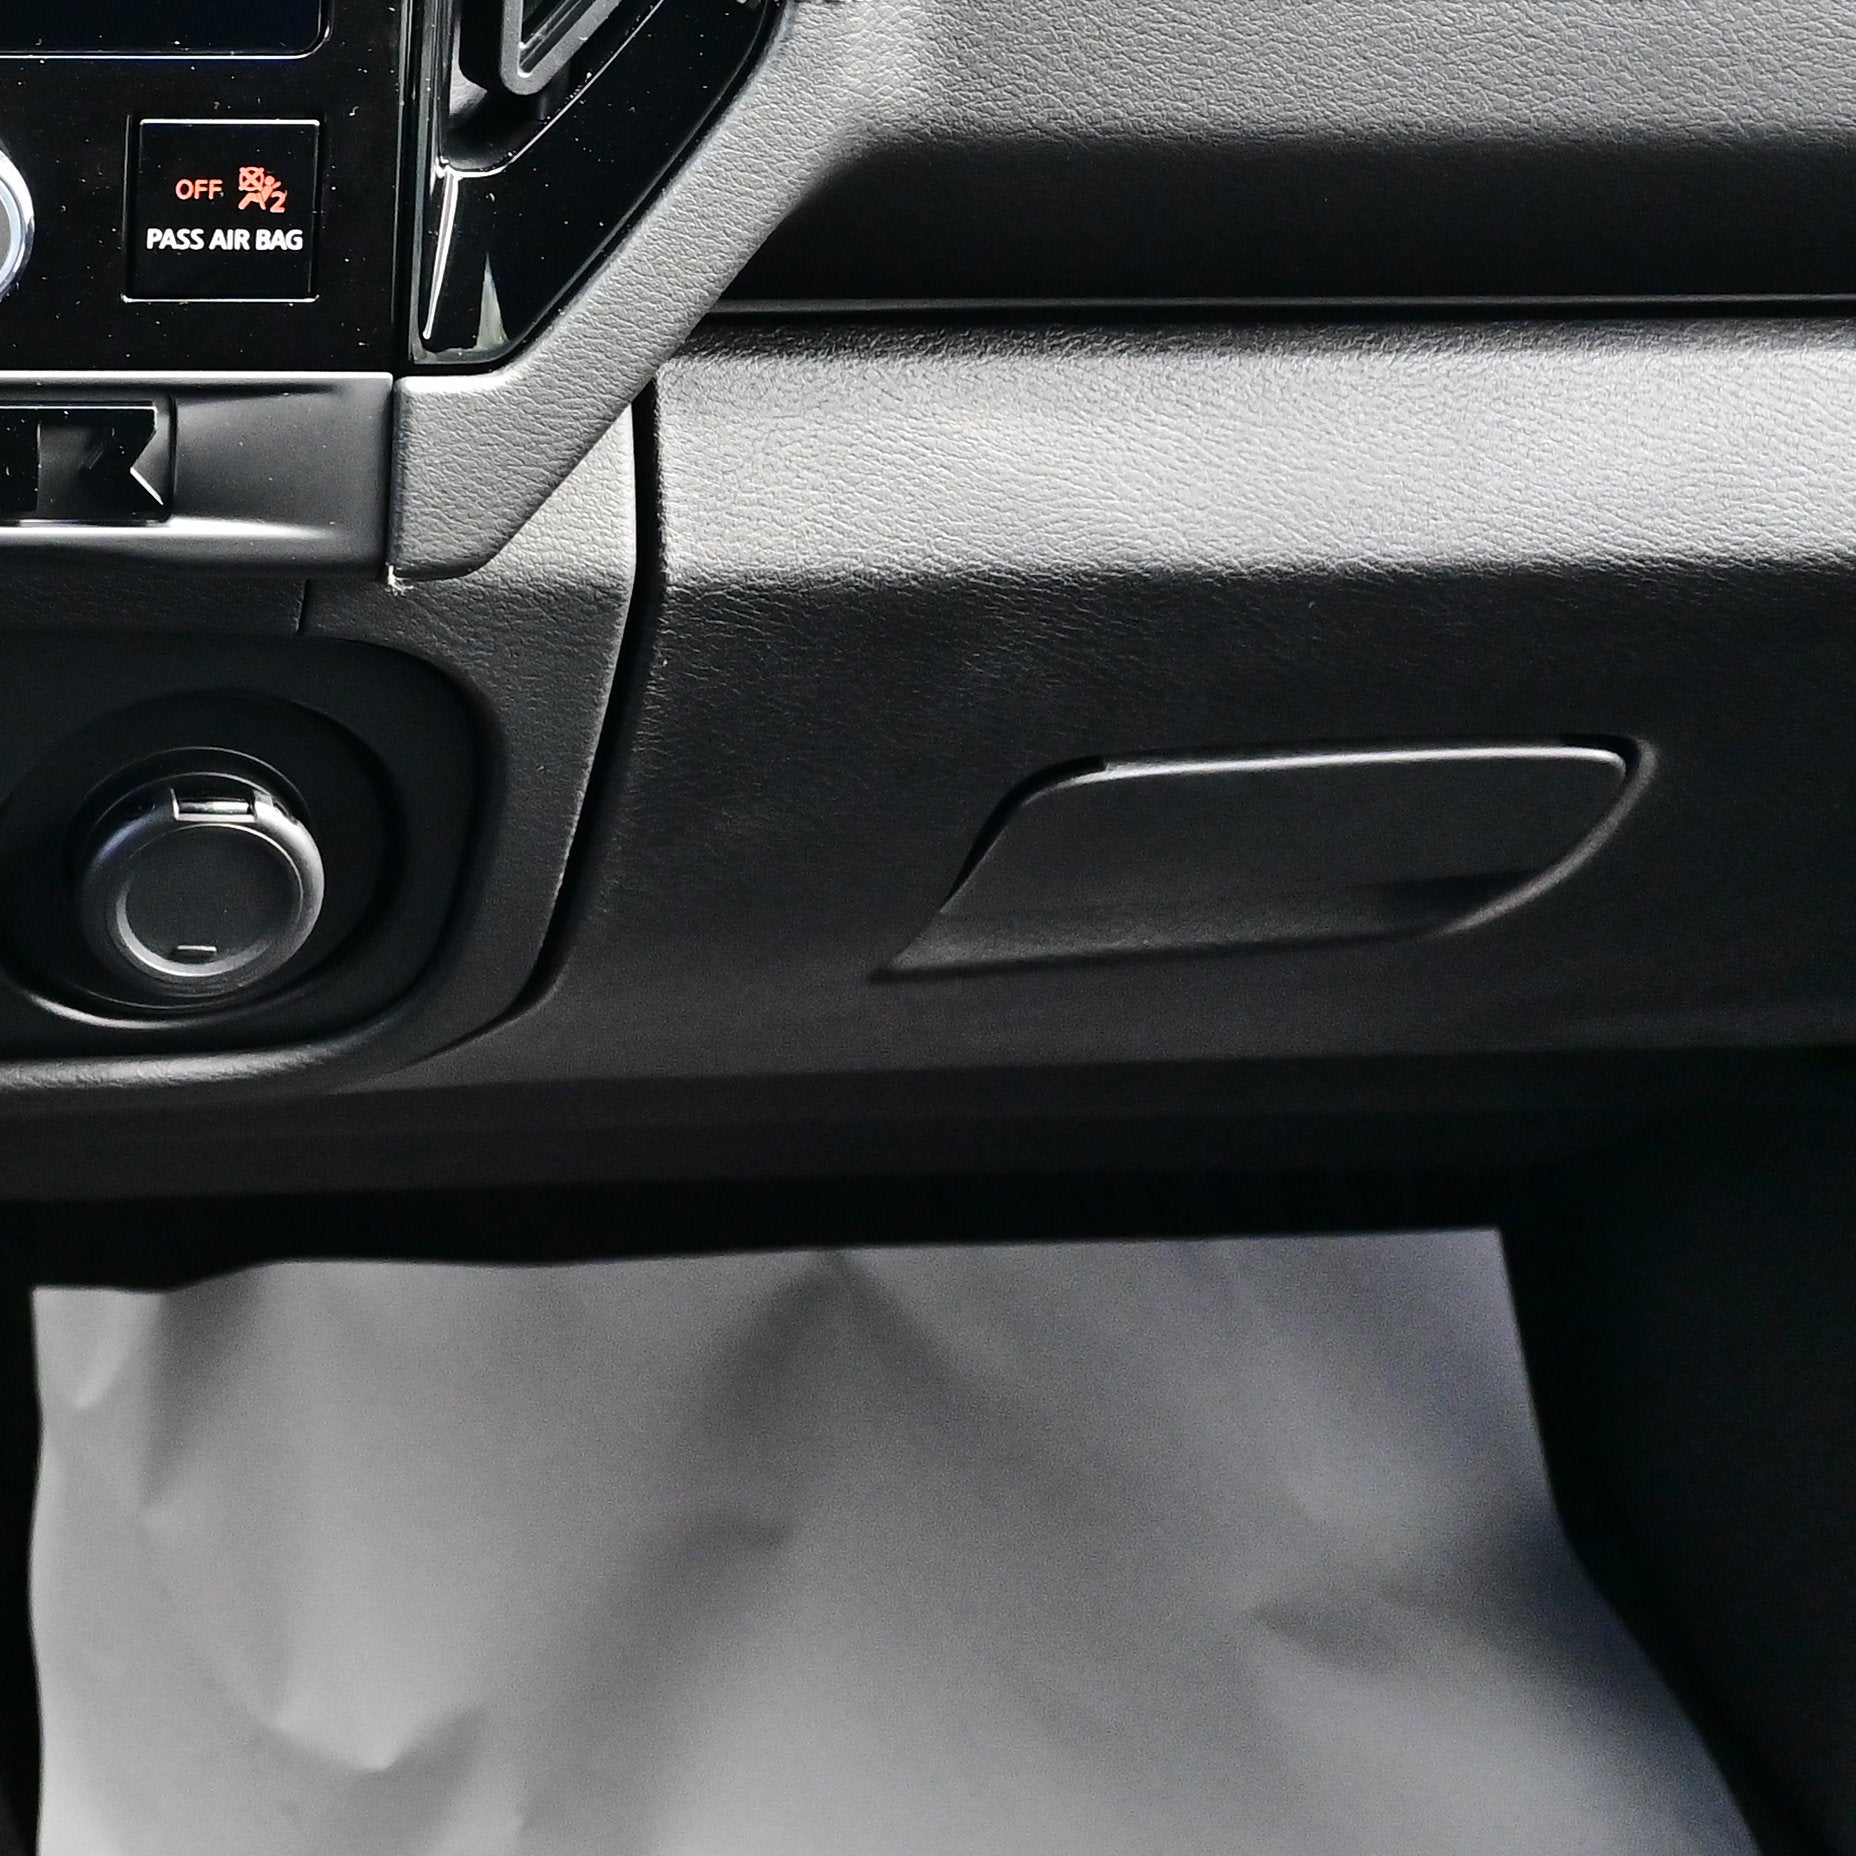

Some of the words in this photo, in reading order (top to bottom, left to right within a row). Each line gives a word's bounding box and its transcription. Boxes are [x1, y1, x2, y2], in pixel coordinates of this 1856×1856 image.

[175, 178, 223, 200] OFF
[146, 228, 205, 251] PASS
[208, 228, 251, 251] AIR
[255, 228, 304, 251] BAG
